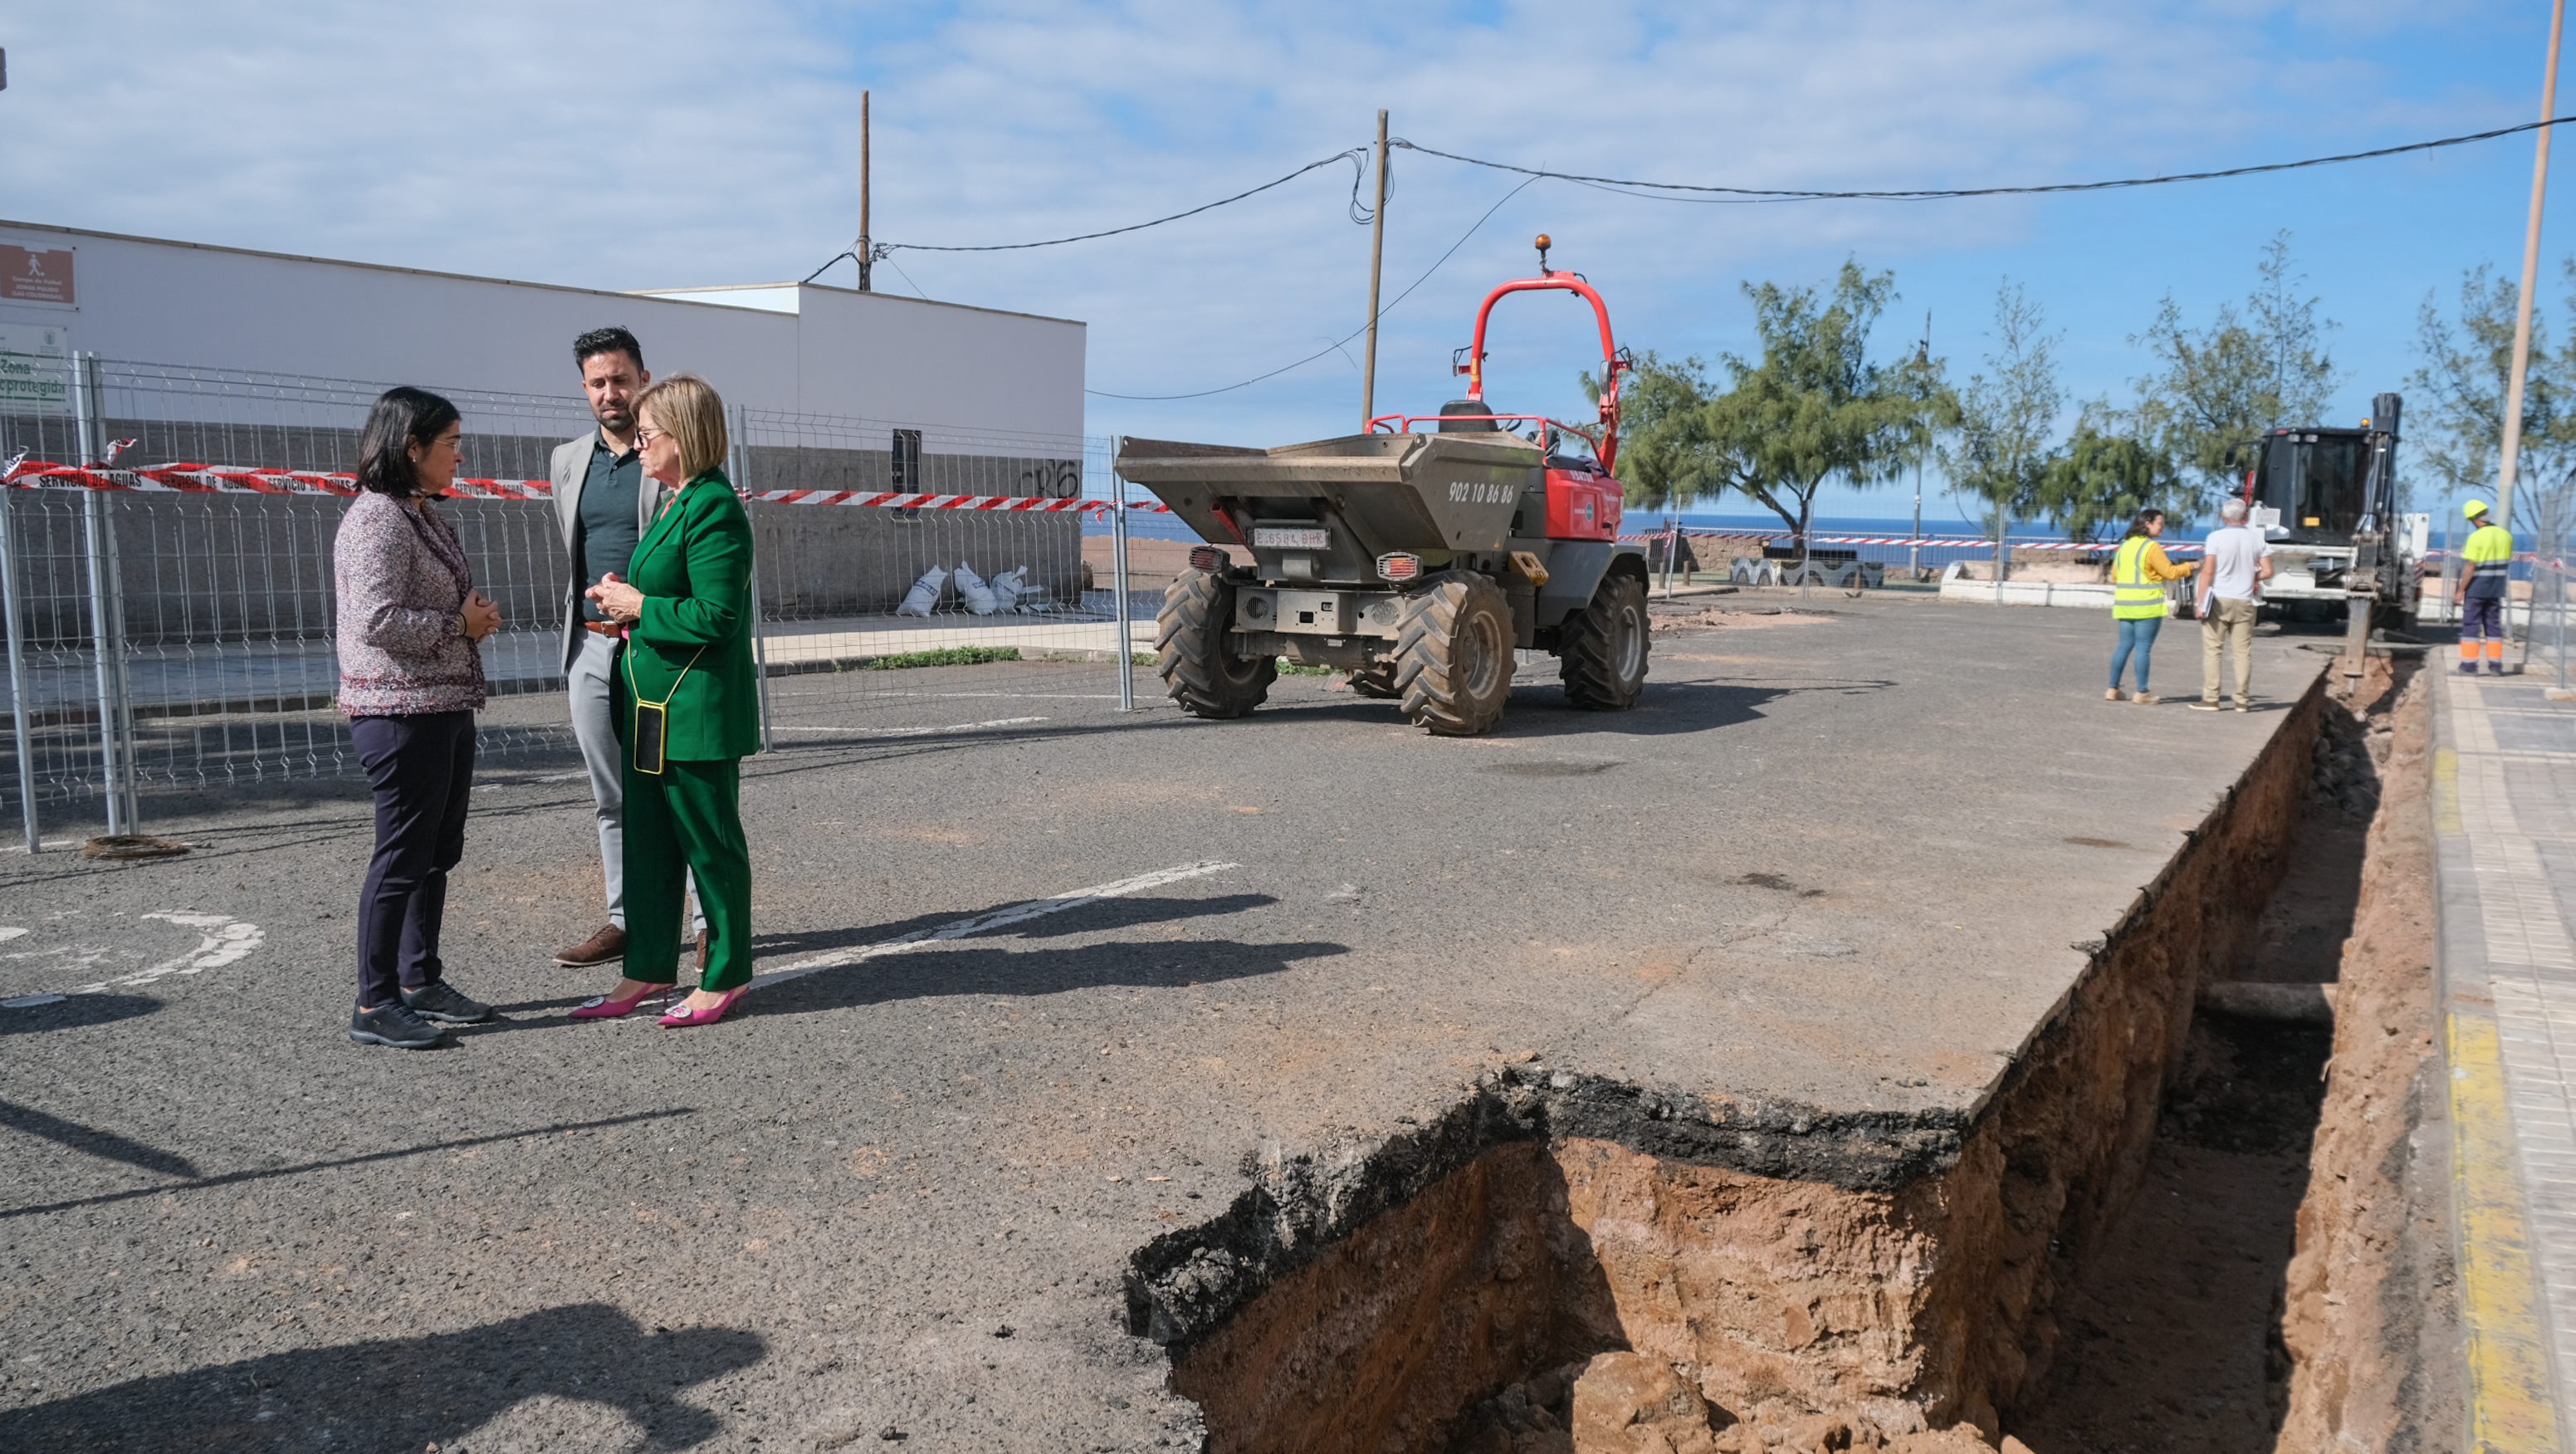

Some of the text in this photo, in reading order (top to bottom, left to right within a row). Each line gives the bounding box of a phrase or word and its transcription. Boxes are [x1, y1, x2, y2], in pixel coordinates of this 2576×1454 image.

[1, 359, 31, 375] Zona
[39, 474, 142, 487] SERVICIO DE AGUAS
[159, 475, 251, 490] SERVICIO DE AGUAS
[267, 477, 351, 492] SERVICIO DE AGUAS
[456, 483, 487, 496] SERVICIO
[1449, 482, 1514, 504] 902 10 86 86
